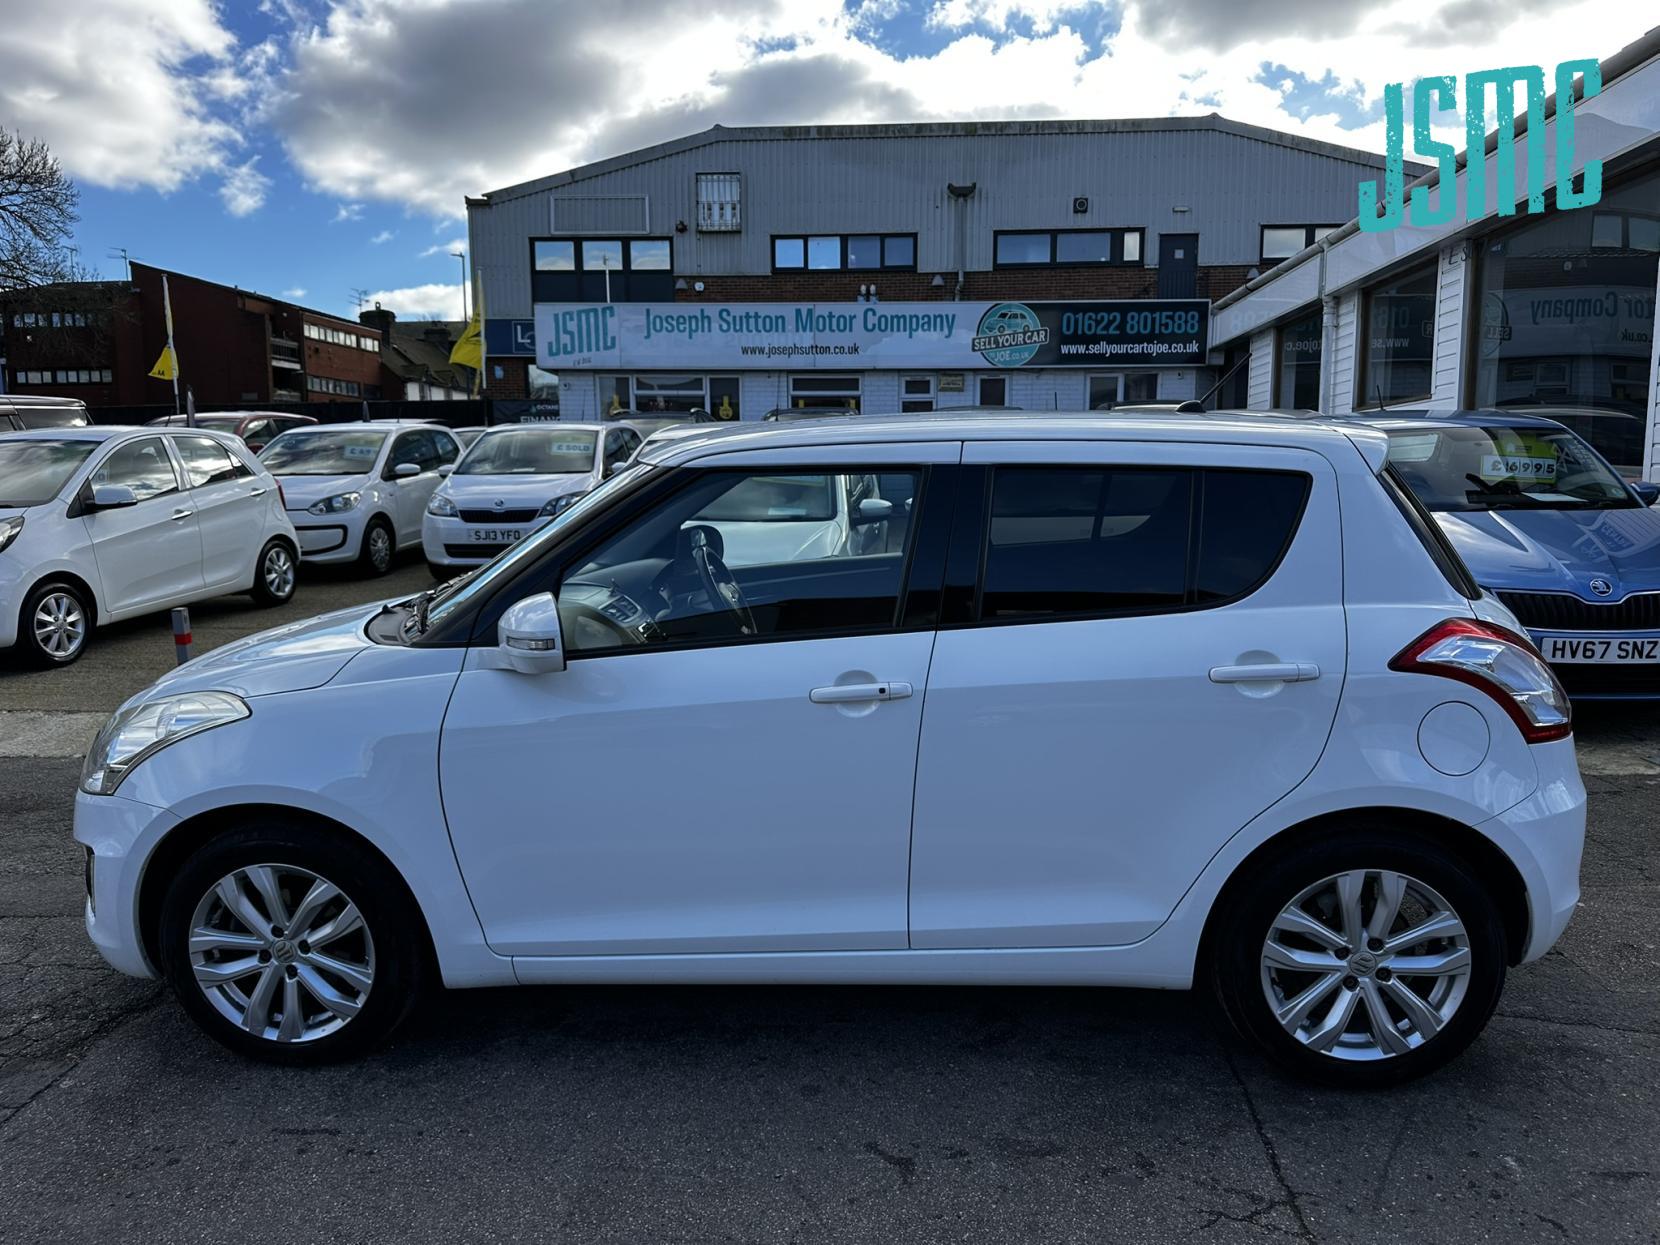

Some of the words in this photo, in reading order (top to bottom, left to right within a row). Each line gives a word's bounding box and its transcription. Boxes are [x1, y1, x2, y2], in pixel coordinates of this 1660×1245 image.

[548, 306, 616, 357] JSMC
[643, 308, 712, 340] Joseph
[718, 308, 786, 333] Sutton
[795, 307, 857, 333] Motor
[863, 307, 956, 339] Company
[1062, 312, 1120, 336] 01622
[1126, 311, 1199, 335] 801588
[973, 337, 996, 350] SELL
[998, 333, 1024, 348] YOUR
[1025, 331, 1046, 344] CAR
[1060, 340, 1200, 357] www.sellyourcartojoe.co.uk
[741, 343, 860, 358] www.josephsutton.co.uk
[474, 530, 497, 541] SJ13
[1551, 640, 1612, 660] HV67
[1616, 640, 1659, 660] SNZ
